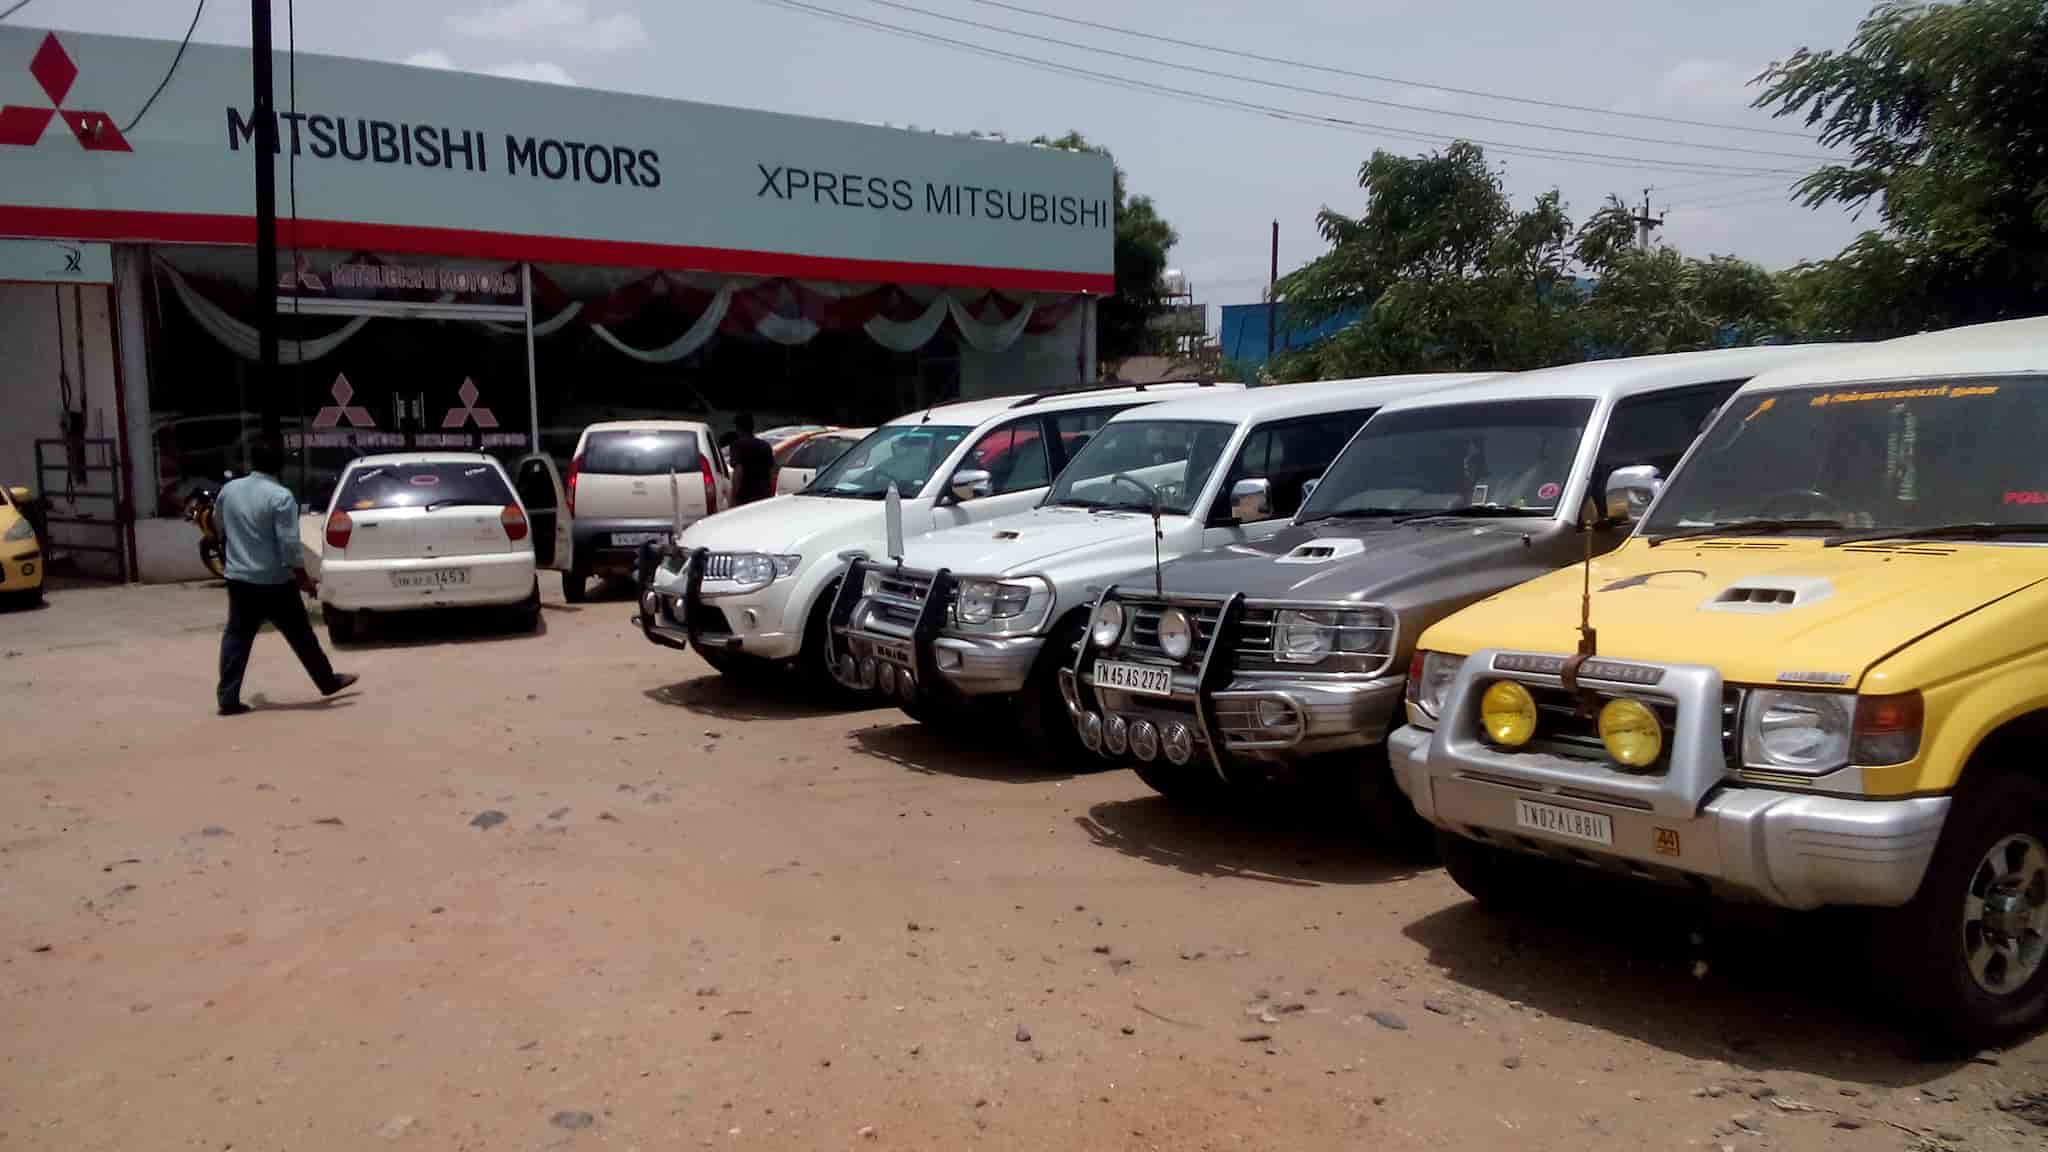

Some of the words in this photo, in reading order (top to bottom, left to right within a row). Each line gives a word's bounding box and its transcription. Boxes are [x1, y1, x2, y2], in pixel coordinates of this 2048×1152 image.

[226, 107, 487, 172] MITSUBISHI
[505, 134, 661, 188] MOTORS
[757, 163, 913, 211] XPRESS
[925, 182, 1107, 229] MITSUBISHI
[1111, 667, 1123, 686] 45
[1126, 668, 1139, 687] AS
[1142, 670, 1169, 691] 2727
[1498, 655, 1659, 682] MITSBISHI
[1521, 803, 1604, 838] TN02AL8811
